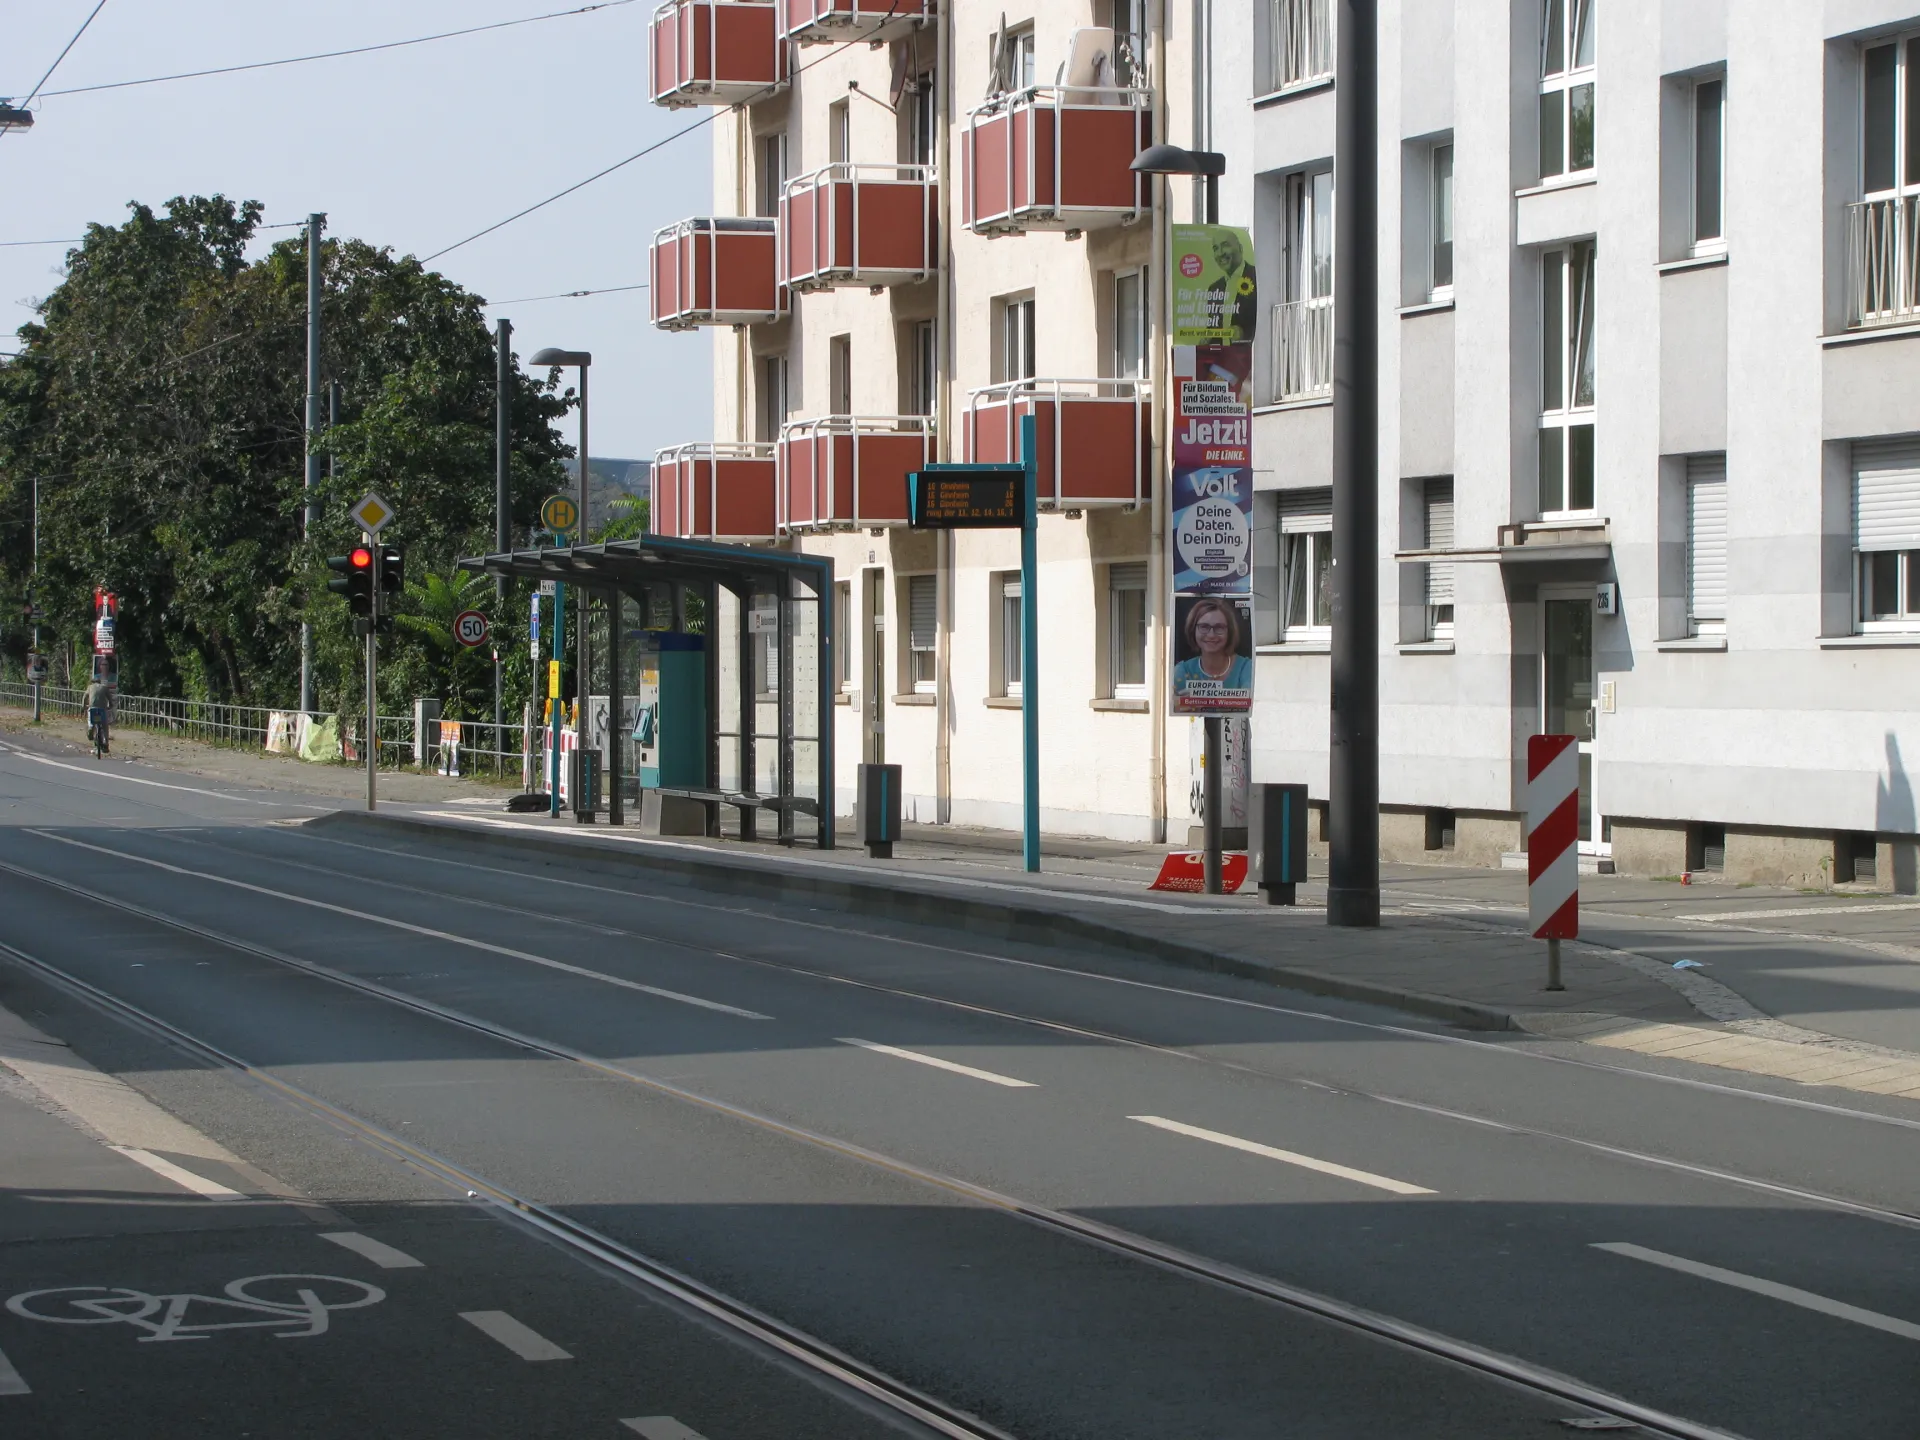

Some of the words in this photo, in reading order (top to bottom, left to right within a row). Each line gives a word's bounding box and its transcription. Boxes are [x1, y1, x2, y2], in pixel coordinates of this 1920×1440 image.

[1178, 288, 1191, 300] Für
[1195, 288, 1230, 301] Frieden
[1177, 302, 1195, 314] und
[1198, 302, 1240, 314] Eintracht
[1177, 315, 1219, 327] weltweit
[1183, 383, 1196, 393] Für
[1197, 383, 1227, 394] Bildung
[1183, 394, 1198, 403] und
[1199, 394, 1235, 403] Soziales:
[1183, 404, 1246, 415] Vermögensteuer.
[1181, 419, 1247, 445] Jetzt!
[1206, 450, 1220, 460] DIE
[1189, 474, 1239, 497] Volt
[553, 503, 569, 525] H
[1197, 505, 1232, 517] Deine
[1195, 519, 1235, 531] Daten.
[1183, 533, 1212, 545] Dein
[1214, 533, 1243, 546] Ding.
[462, 620, 482, 637] 50
[96, 640, 114, 649] Jetzt!
[1188, 681, 1217, 689] EUROPA
[1184, 854, 1233, 866] SD
